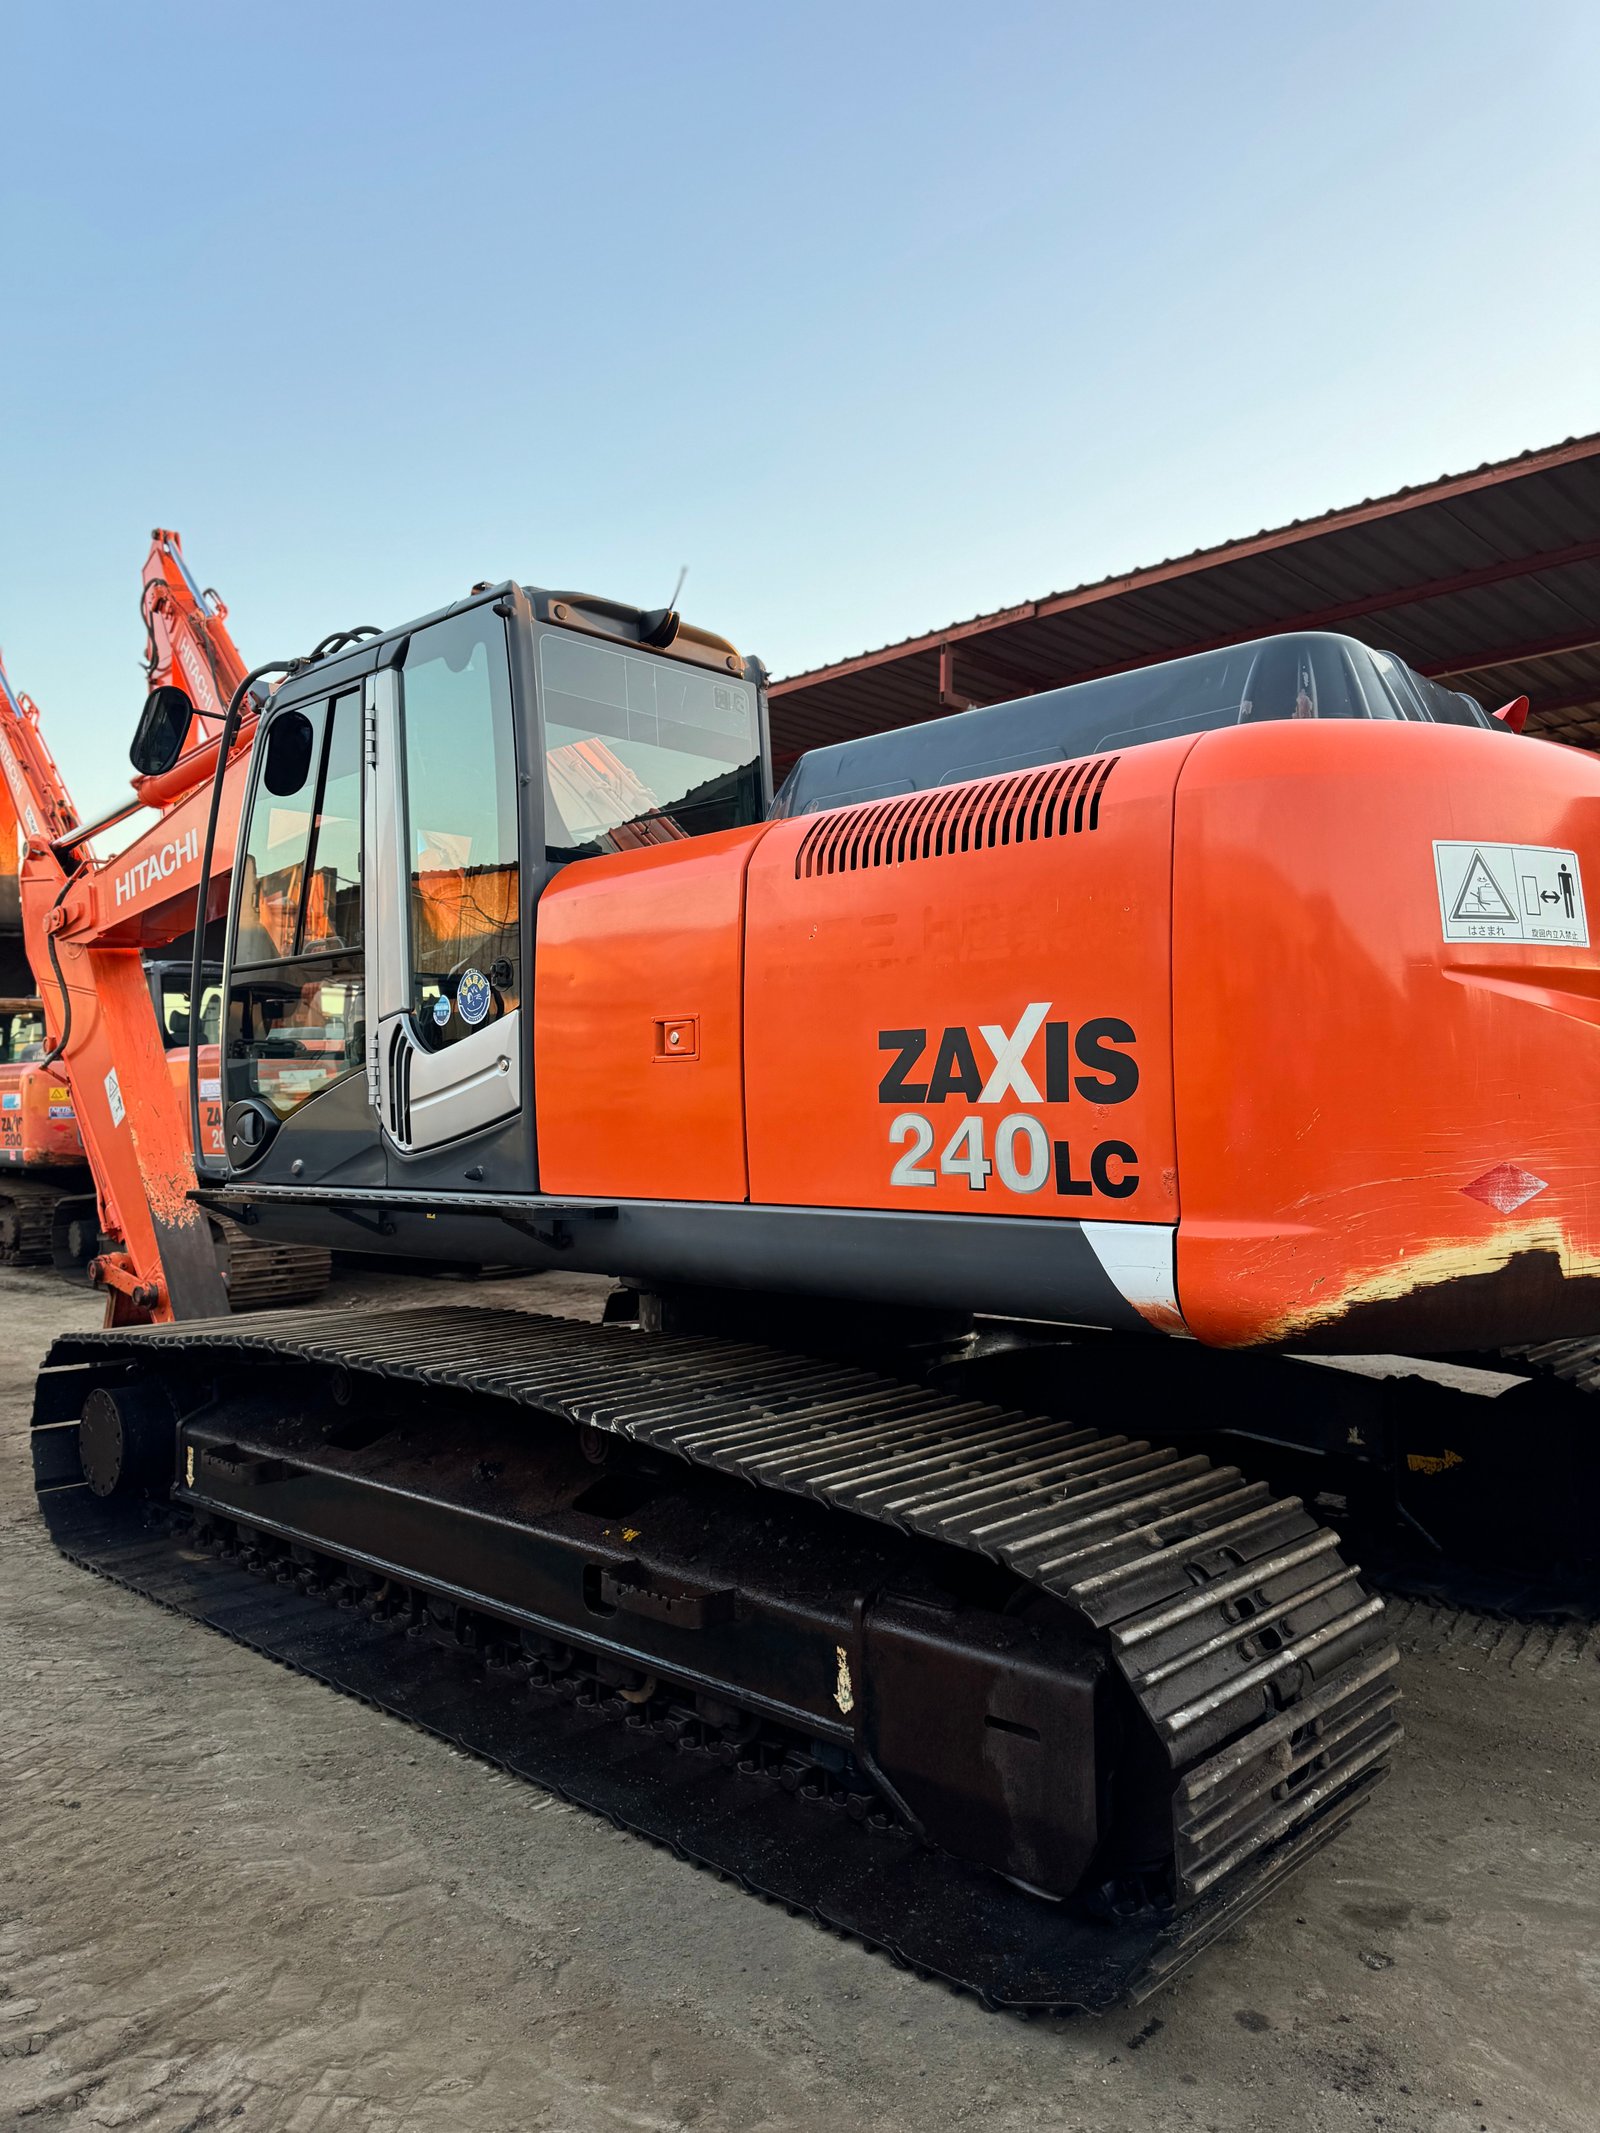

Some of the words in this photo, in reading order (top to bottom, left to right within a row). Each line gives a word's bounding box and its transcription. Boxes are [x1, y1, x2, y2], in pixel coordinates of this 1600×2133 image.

[180, 638, 213, 712] HITACHI
[115, 827, 199, 907] HITACHI
[1467, 925, 1506, 936] はさまれ
[878, 1001, 1140, 1105] ZAXIS
[4, 1133, 22, 1146] 200
